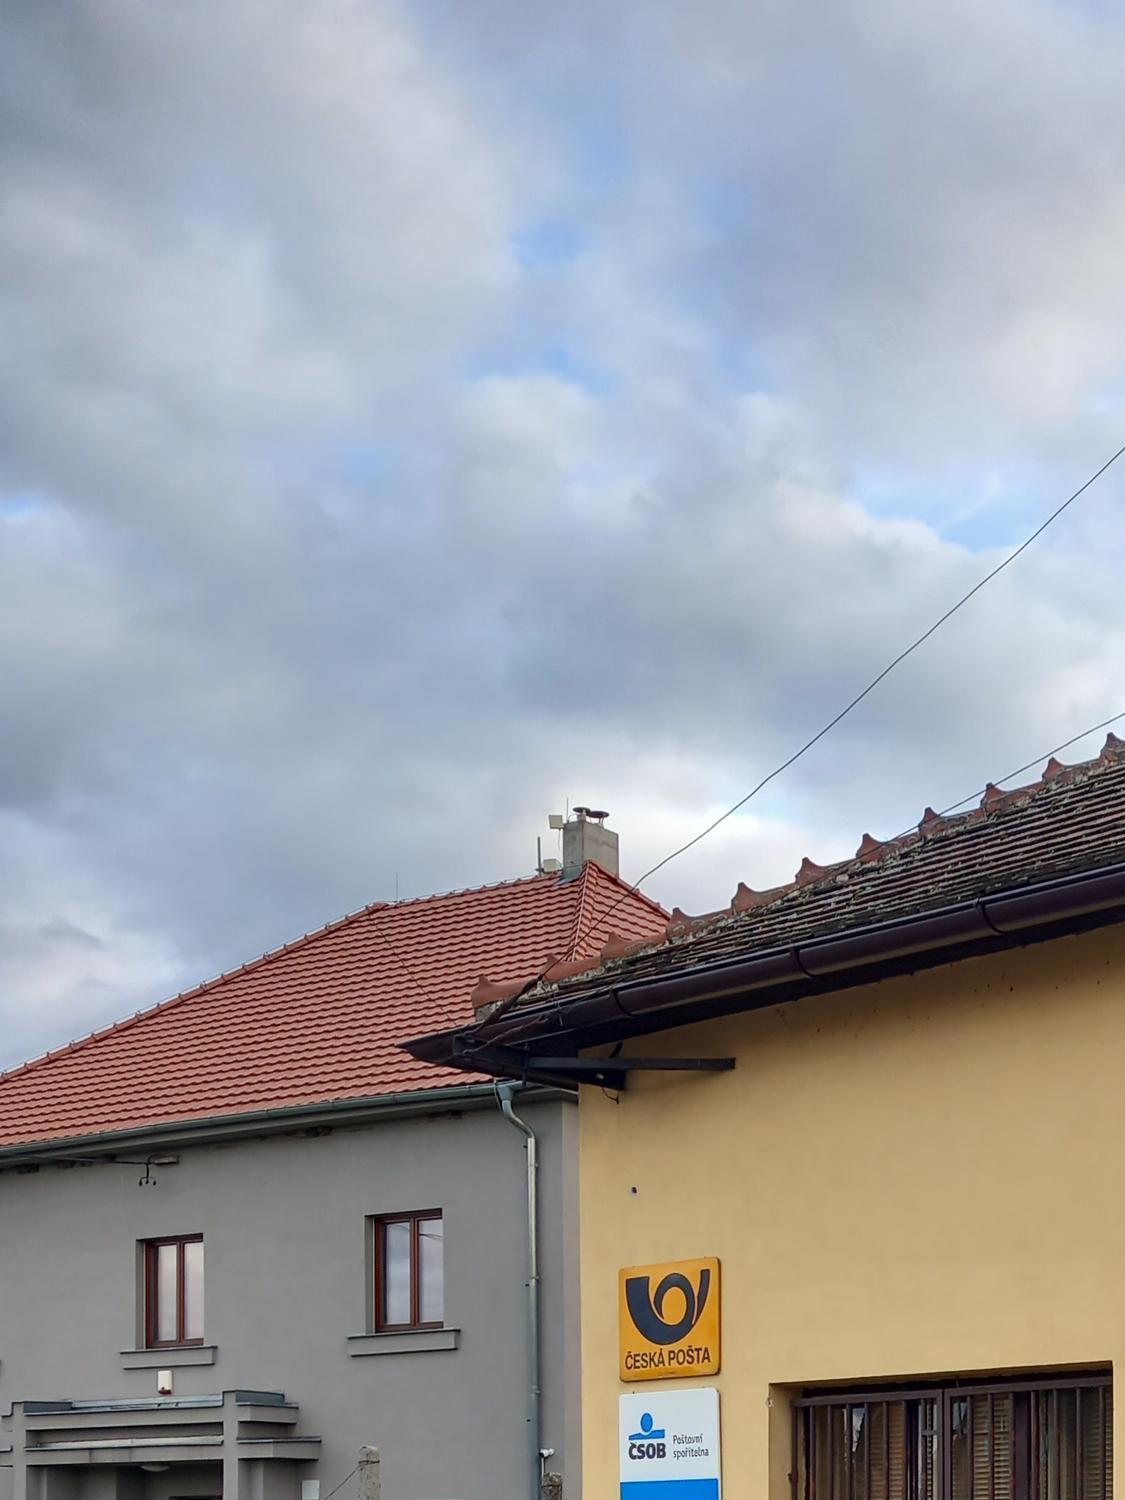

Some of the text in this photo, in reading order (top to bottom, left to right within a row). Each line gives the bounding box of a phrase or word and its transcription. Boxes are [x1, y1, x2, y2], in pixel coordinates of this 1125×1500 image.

[625, 1345, 711, 1370] ČESKÁ POŠTA
[673, 1433, 703, 1445] Poštovní
[628, 1442, 667, 1460] ČSOB
[673, 1446, 709, 1460] spořitelna
